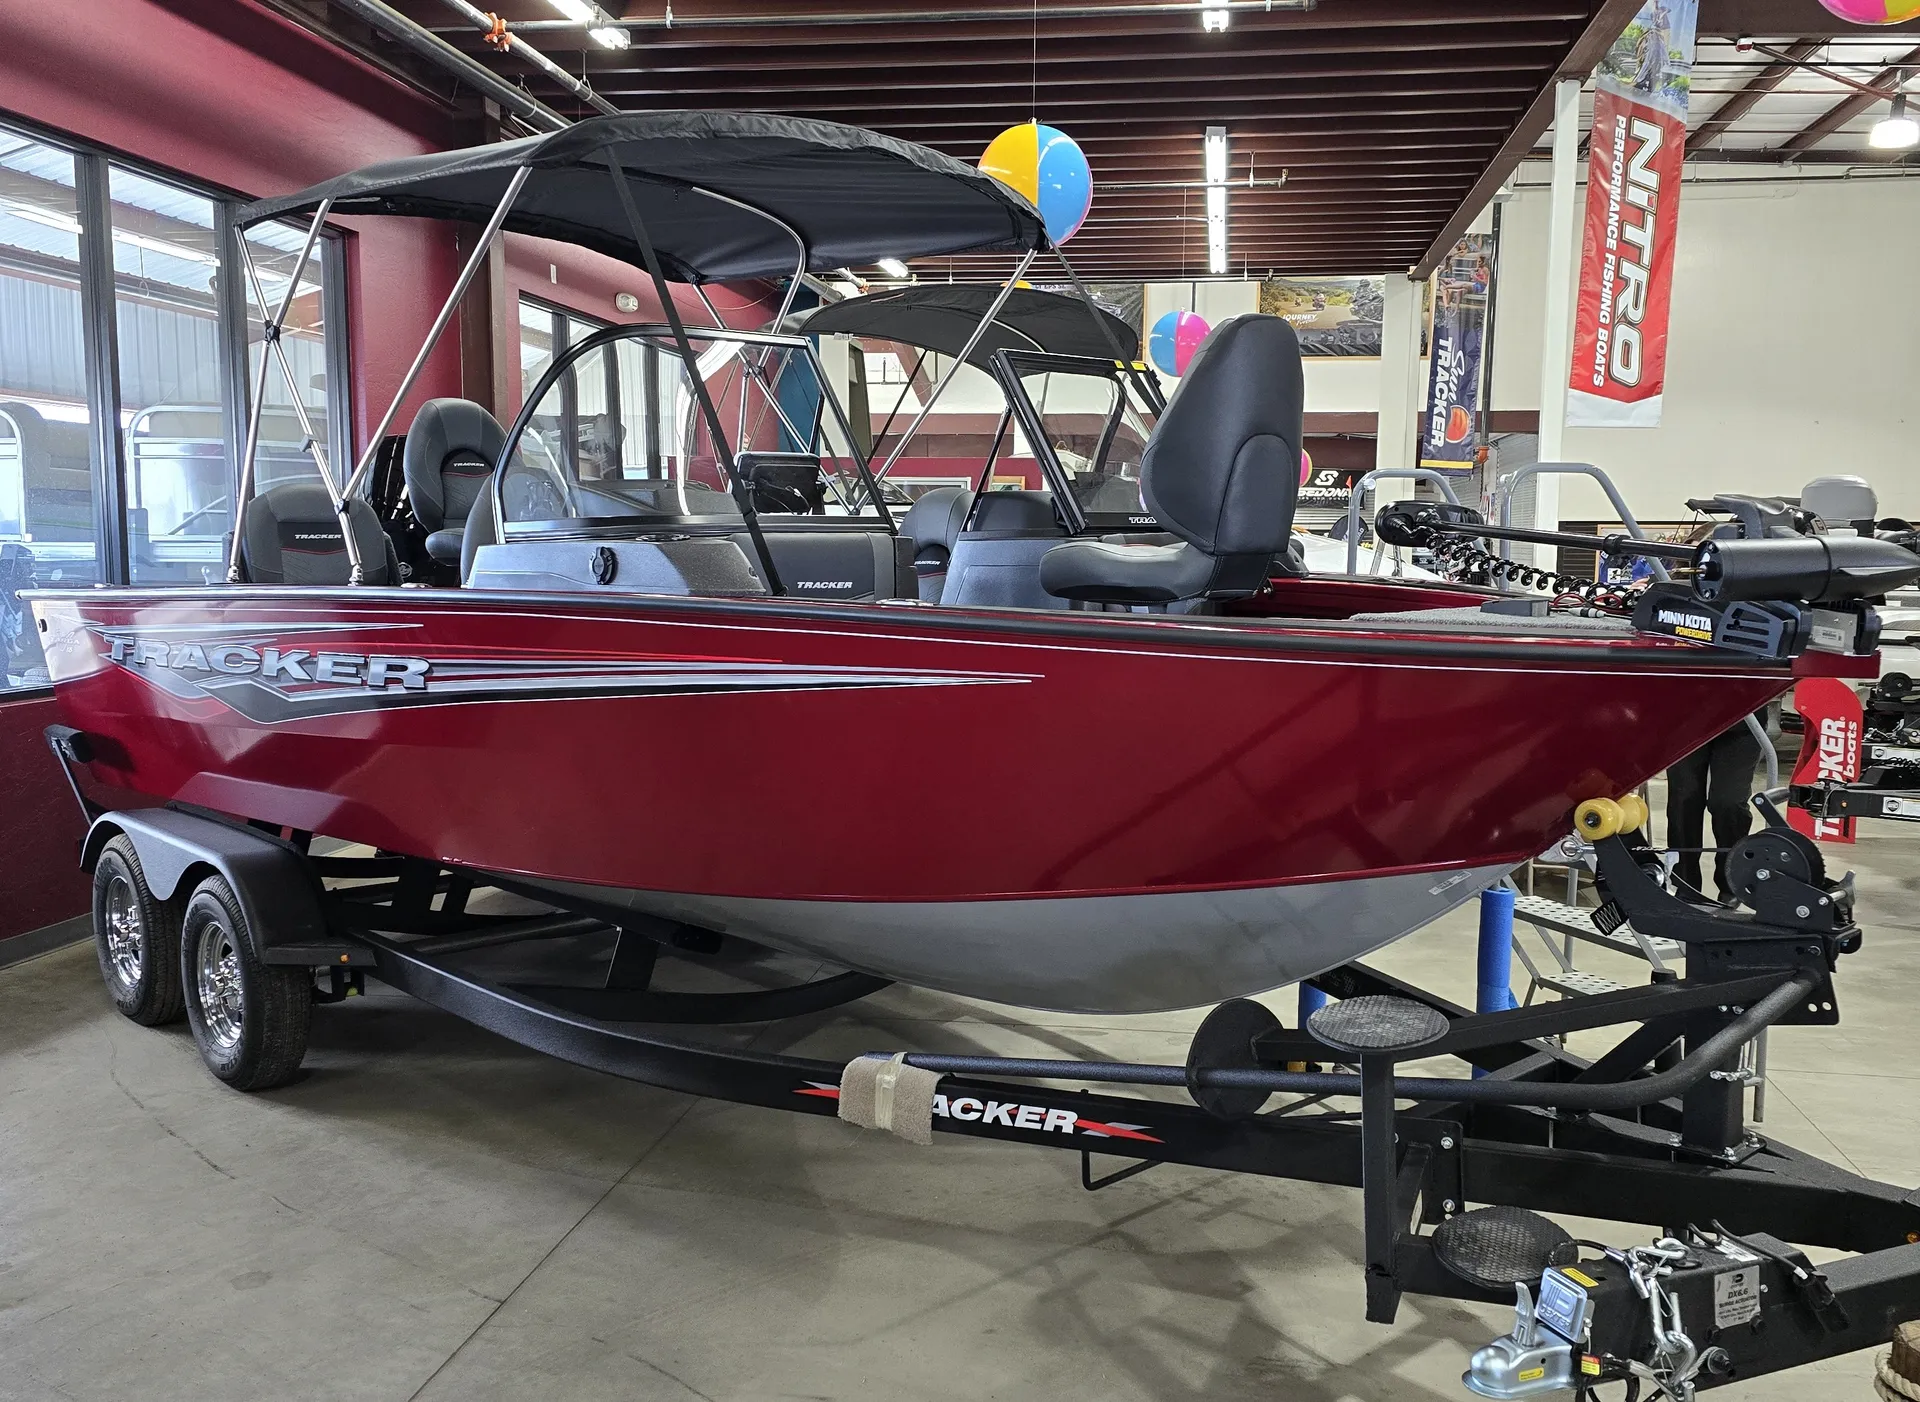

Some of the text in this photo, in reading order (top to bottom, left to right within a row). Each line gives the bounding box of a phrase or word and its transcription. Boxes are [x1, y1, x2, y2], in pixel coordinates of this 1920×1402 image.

[1592, 114, 1627, 388] PERFORMANCE FISHING BOATS
[1282, 313, 1318, 321] JOURNEY
[1430, 336, 1453, 448] TRACKER
[1448, 343, 1465, 403] Sun
[796, 581, 853, 589] TRACKER
[1658, 609, 1712, 631] MINN KOTA
[1674, 626, 1713, 641] POWERDRIVE
[103, 633, 431, 689] TRACKER
[1814, 717, 1847, 838] TCKER
[1843, 721, 1857, 778] boats
[931, 1094, 1078, 1134] ACKER
